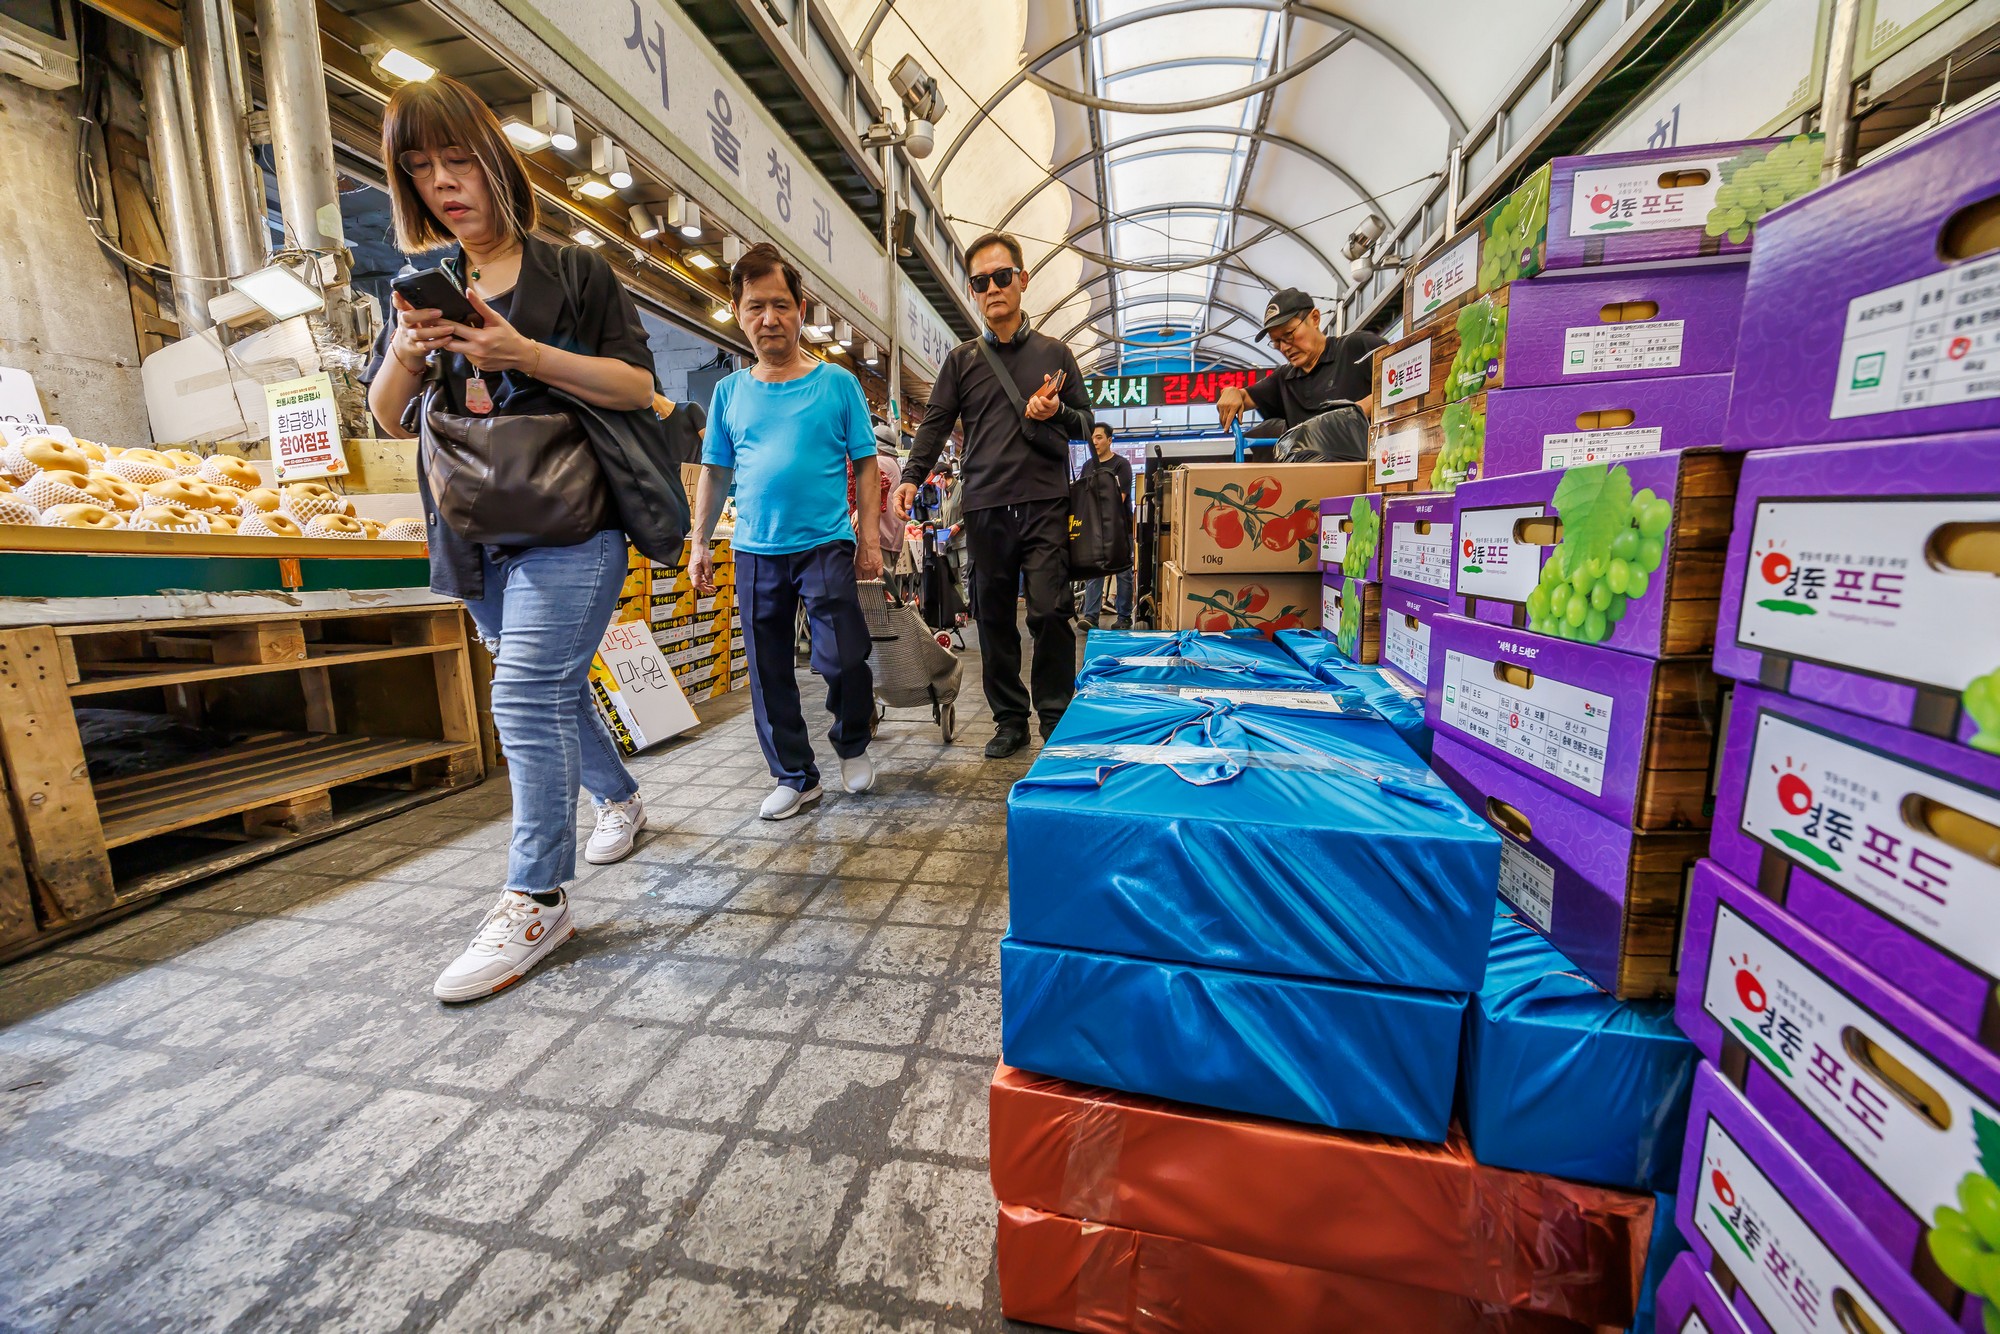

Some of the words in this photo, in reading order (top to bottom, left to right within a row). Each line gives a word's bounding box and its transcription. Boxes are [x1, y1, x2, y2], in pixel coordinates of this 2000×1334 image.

[1641, 193, 1684, 215] 포도
[1444, 262, 1464, 291] 포도
[1405, 361, 1422, 382] 포도
[277, 407, 327, 434] 환급행사
[280, 430, 331, 456] 참여점포
[1201, 555, 1223, 565] 10kg
[1463, 539, 1485, 564] 영동
[1487, 545, 1508, 565] 포도
[1761, 552, 1826, 600] 영동
[1830, 569, 1905, 608] 포도
[616, 655, 668, 693] 만원
[1777, 773, 1854, 854] 영동
[1858, 824, 1953, 906] 포도
[1735, 969, 1804, 1061] 영동
[1807, 1042, 1889, 1142] 포도
[1764, 1241, 1820, 1328] 포도
